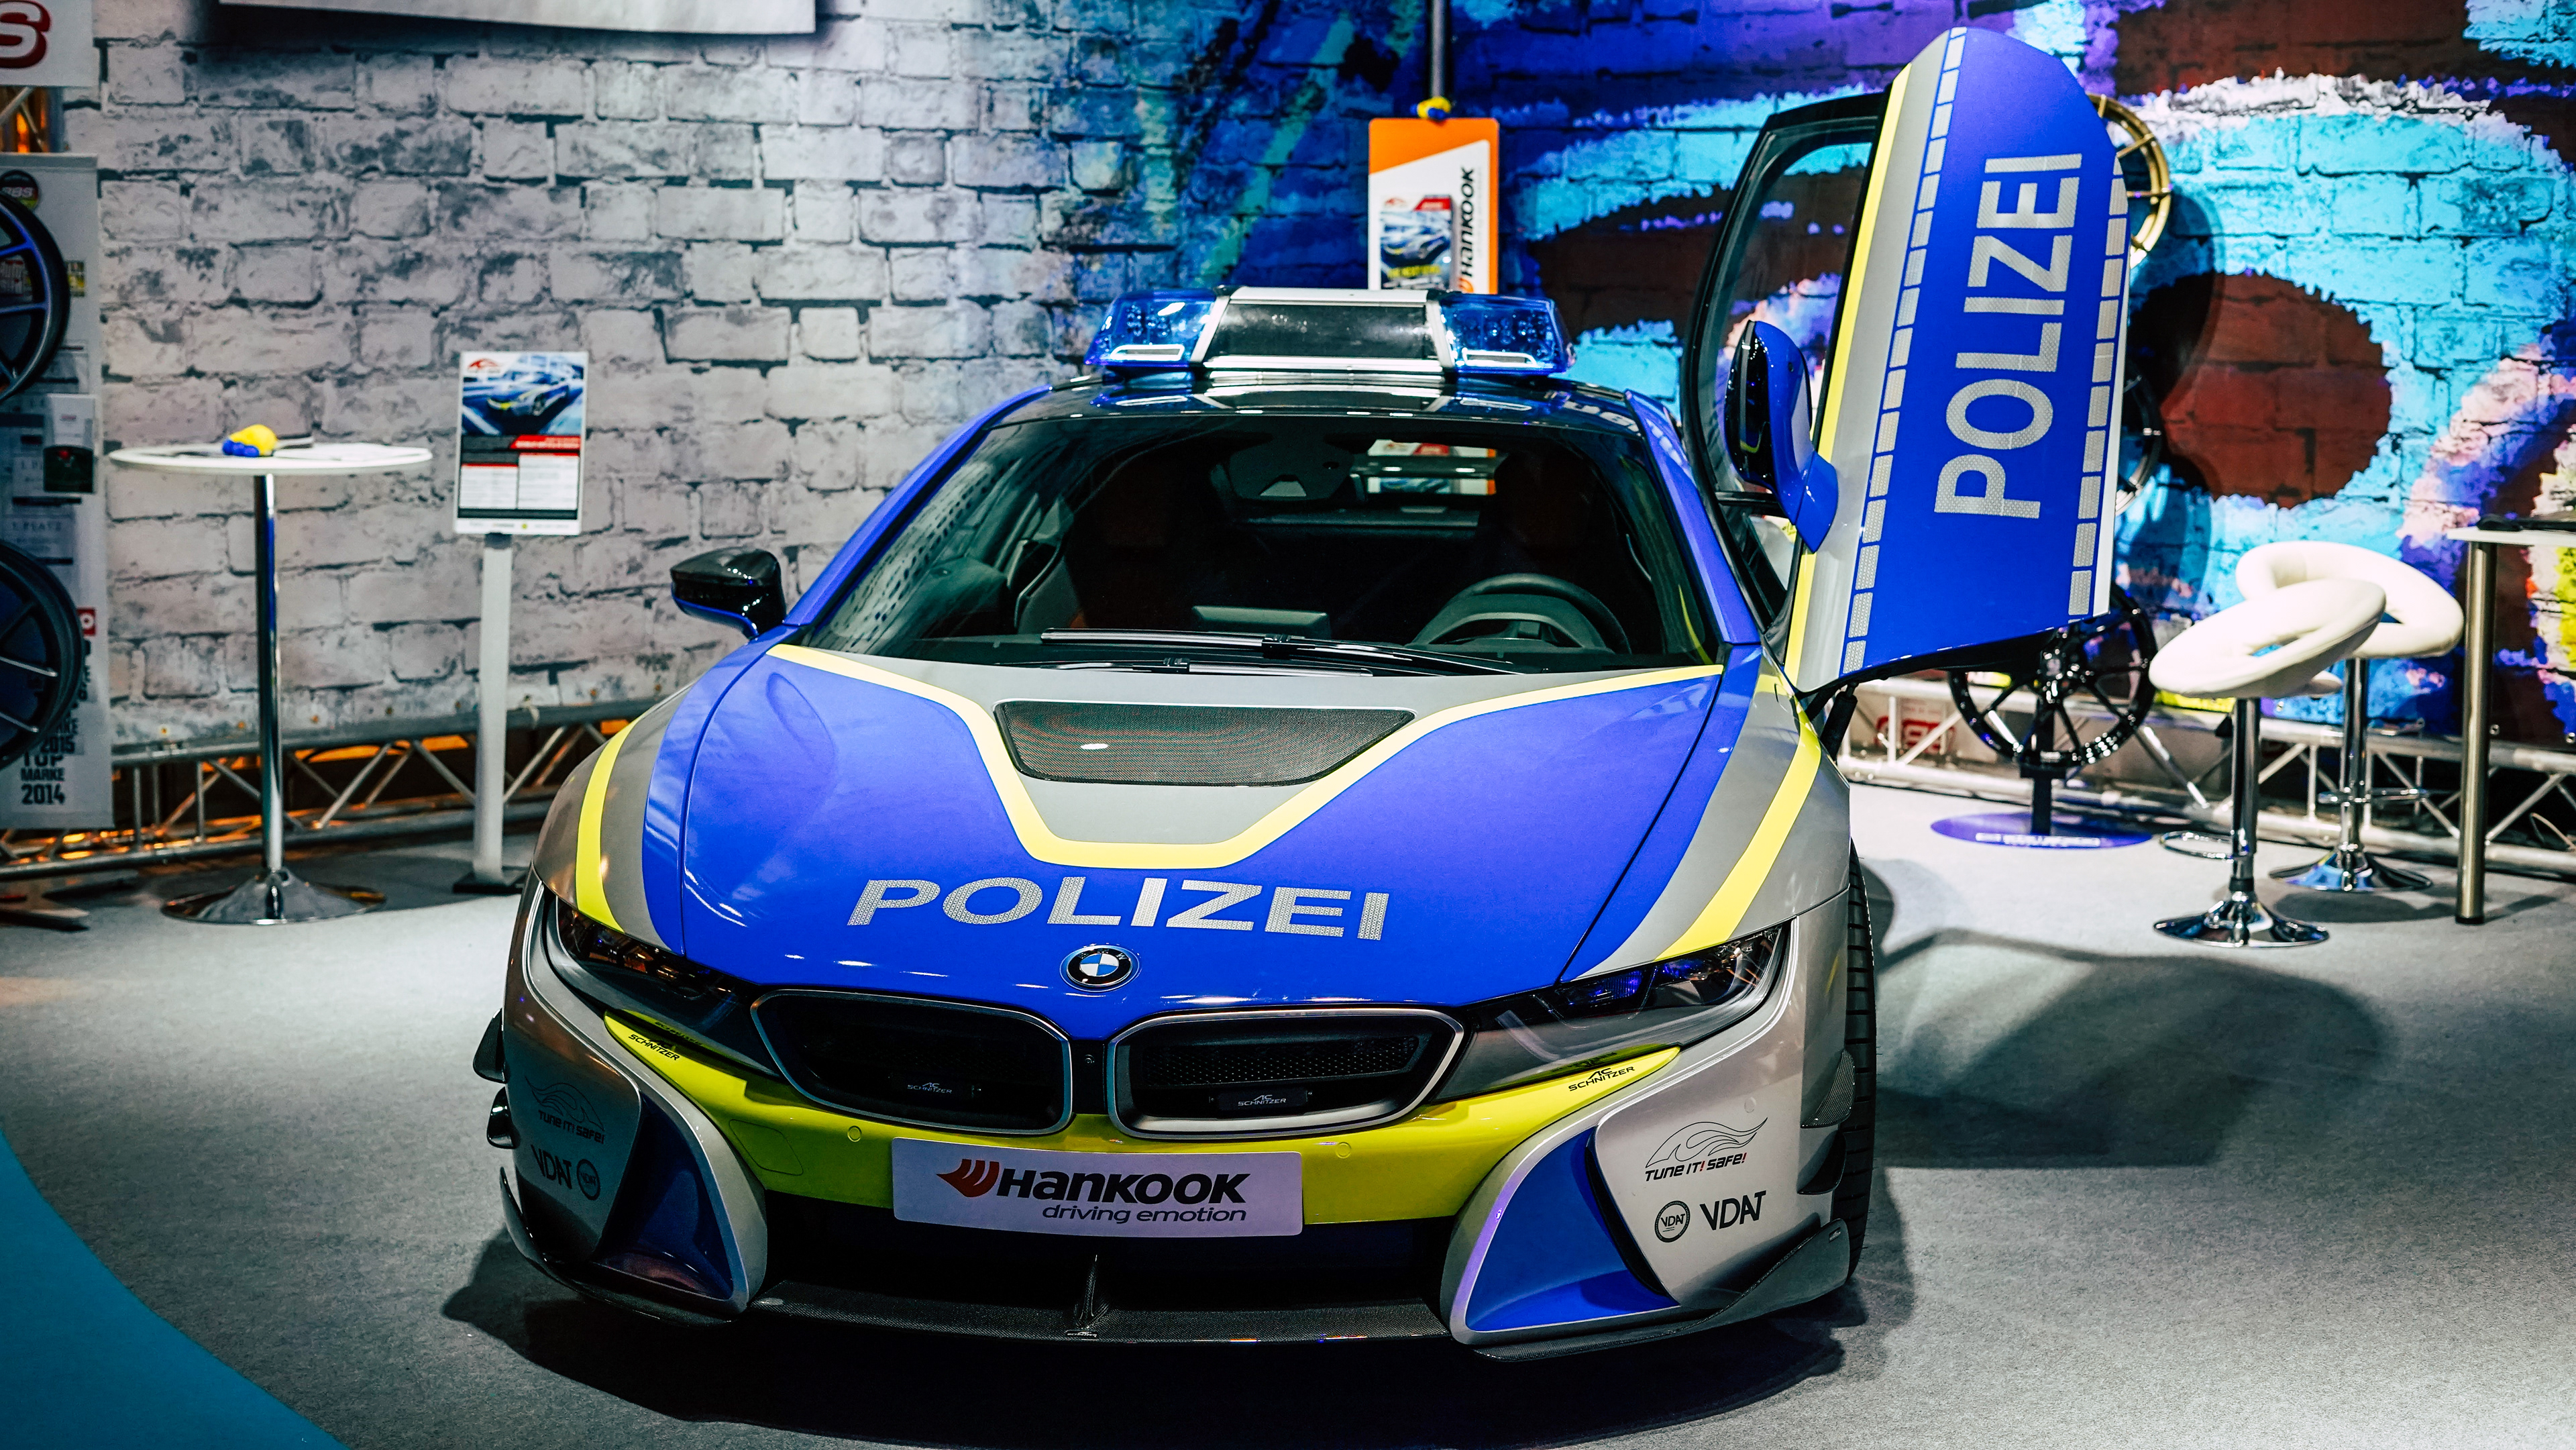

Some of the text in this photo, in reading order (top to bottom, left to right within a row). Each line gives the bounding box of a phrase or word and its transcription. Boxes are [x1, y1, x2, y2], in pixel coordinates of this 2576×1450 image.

[1934, 153, 2082, 519] POLIZEI
[21, 767, 65, 781] MARKE
[21, 783, 65, 805] 2014
[847, 876, 1389, 941] POLIZEI
[629, 1034, 680, 1061] SCHNITZER
[1568, 1066, 1635, 1092] SCHNITZER
[1587, 1068, 1613, 1080] AC
[907, 1084, 953, 1094] SCHNITZER
[1238, 1098, 1287, 1106] SCHNITZER
[531, 1144, 573, 1189] VDAT
[1686, 1161, 1705, 1175] IT!
[1042, 1204, 1246, 1224] driving emotion
[1660, 1213, 1686, 1227] VDAT
[1699, 1190, 1767, 1231] VDAT
